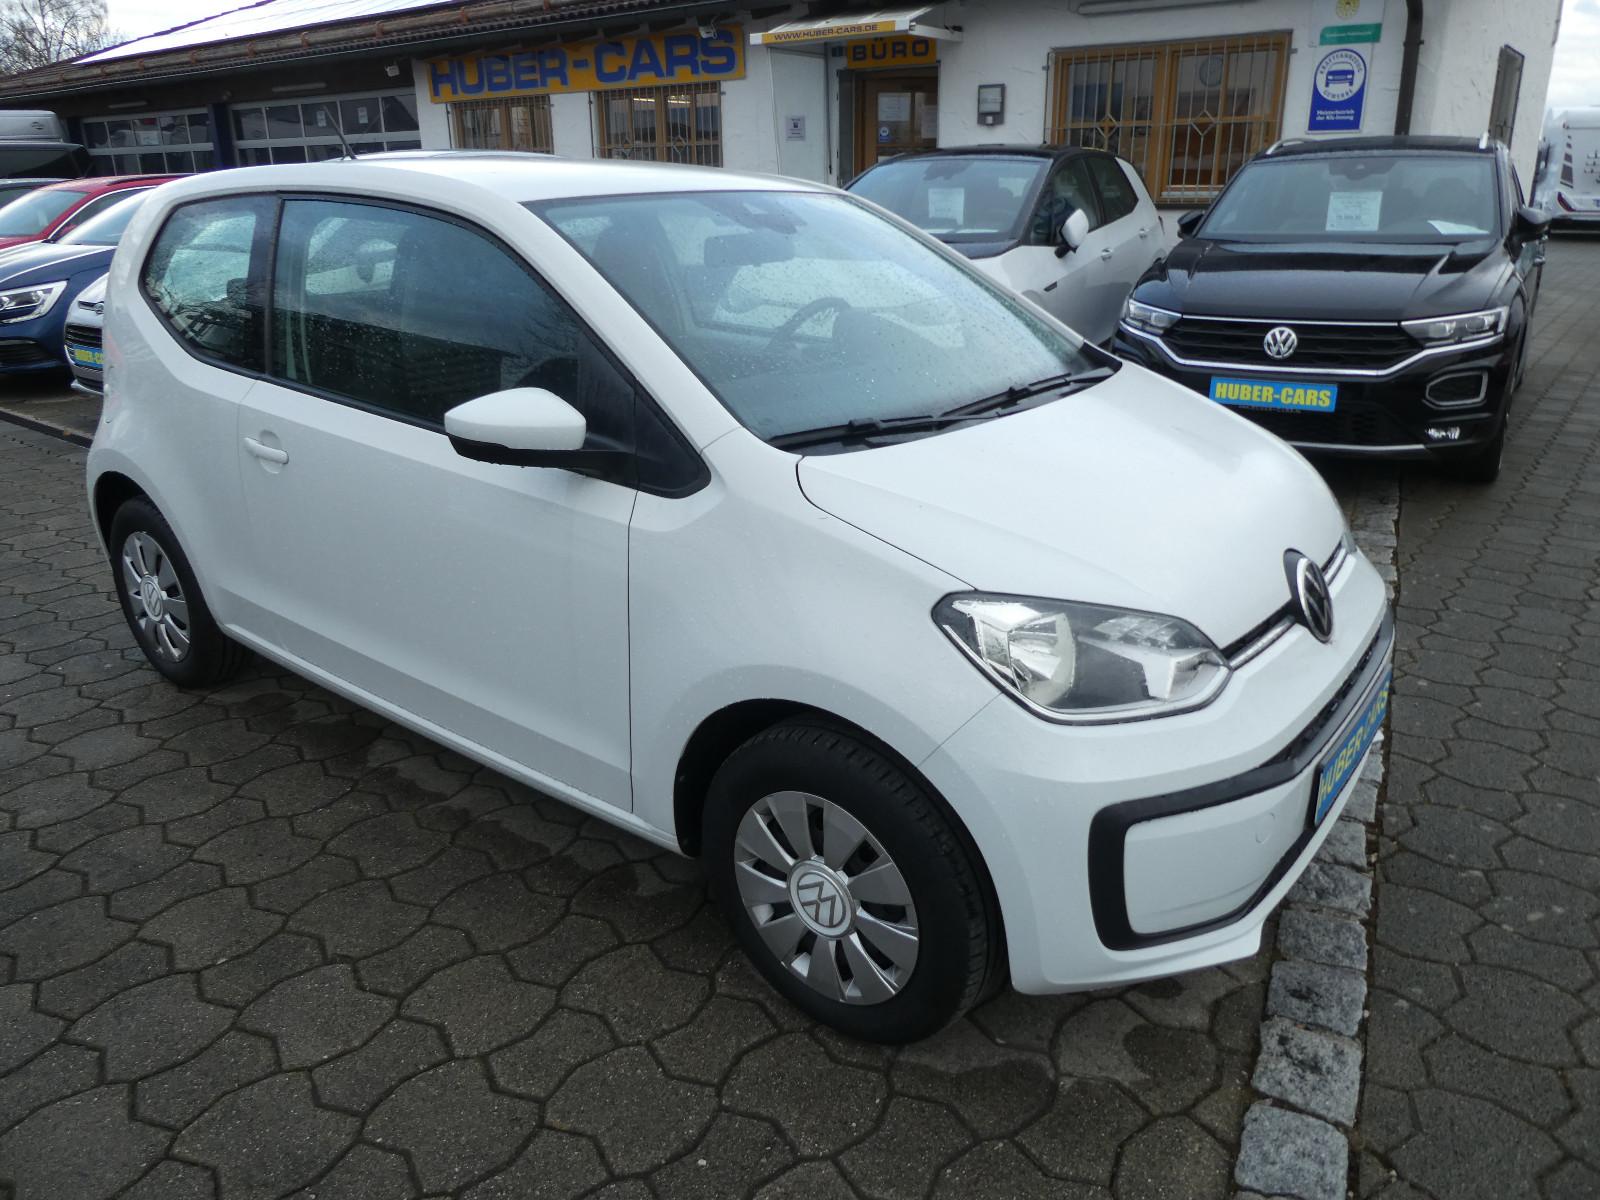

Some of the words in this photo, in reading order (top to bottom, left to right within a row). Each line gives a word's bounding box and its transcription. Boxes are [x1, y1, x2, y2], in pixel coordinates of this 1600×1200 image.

[774, 24, 879, 41] WWW.HUBER-CARS.DE
[852, 37, 930, 62] BÜRO
[431, 31, 737, 97] HUBER-CARS
[1215, 382, 1331, 407] HUBER-CARS
